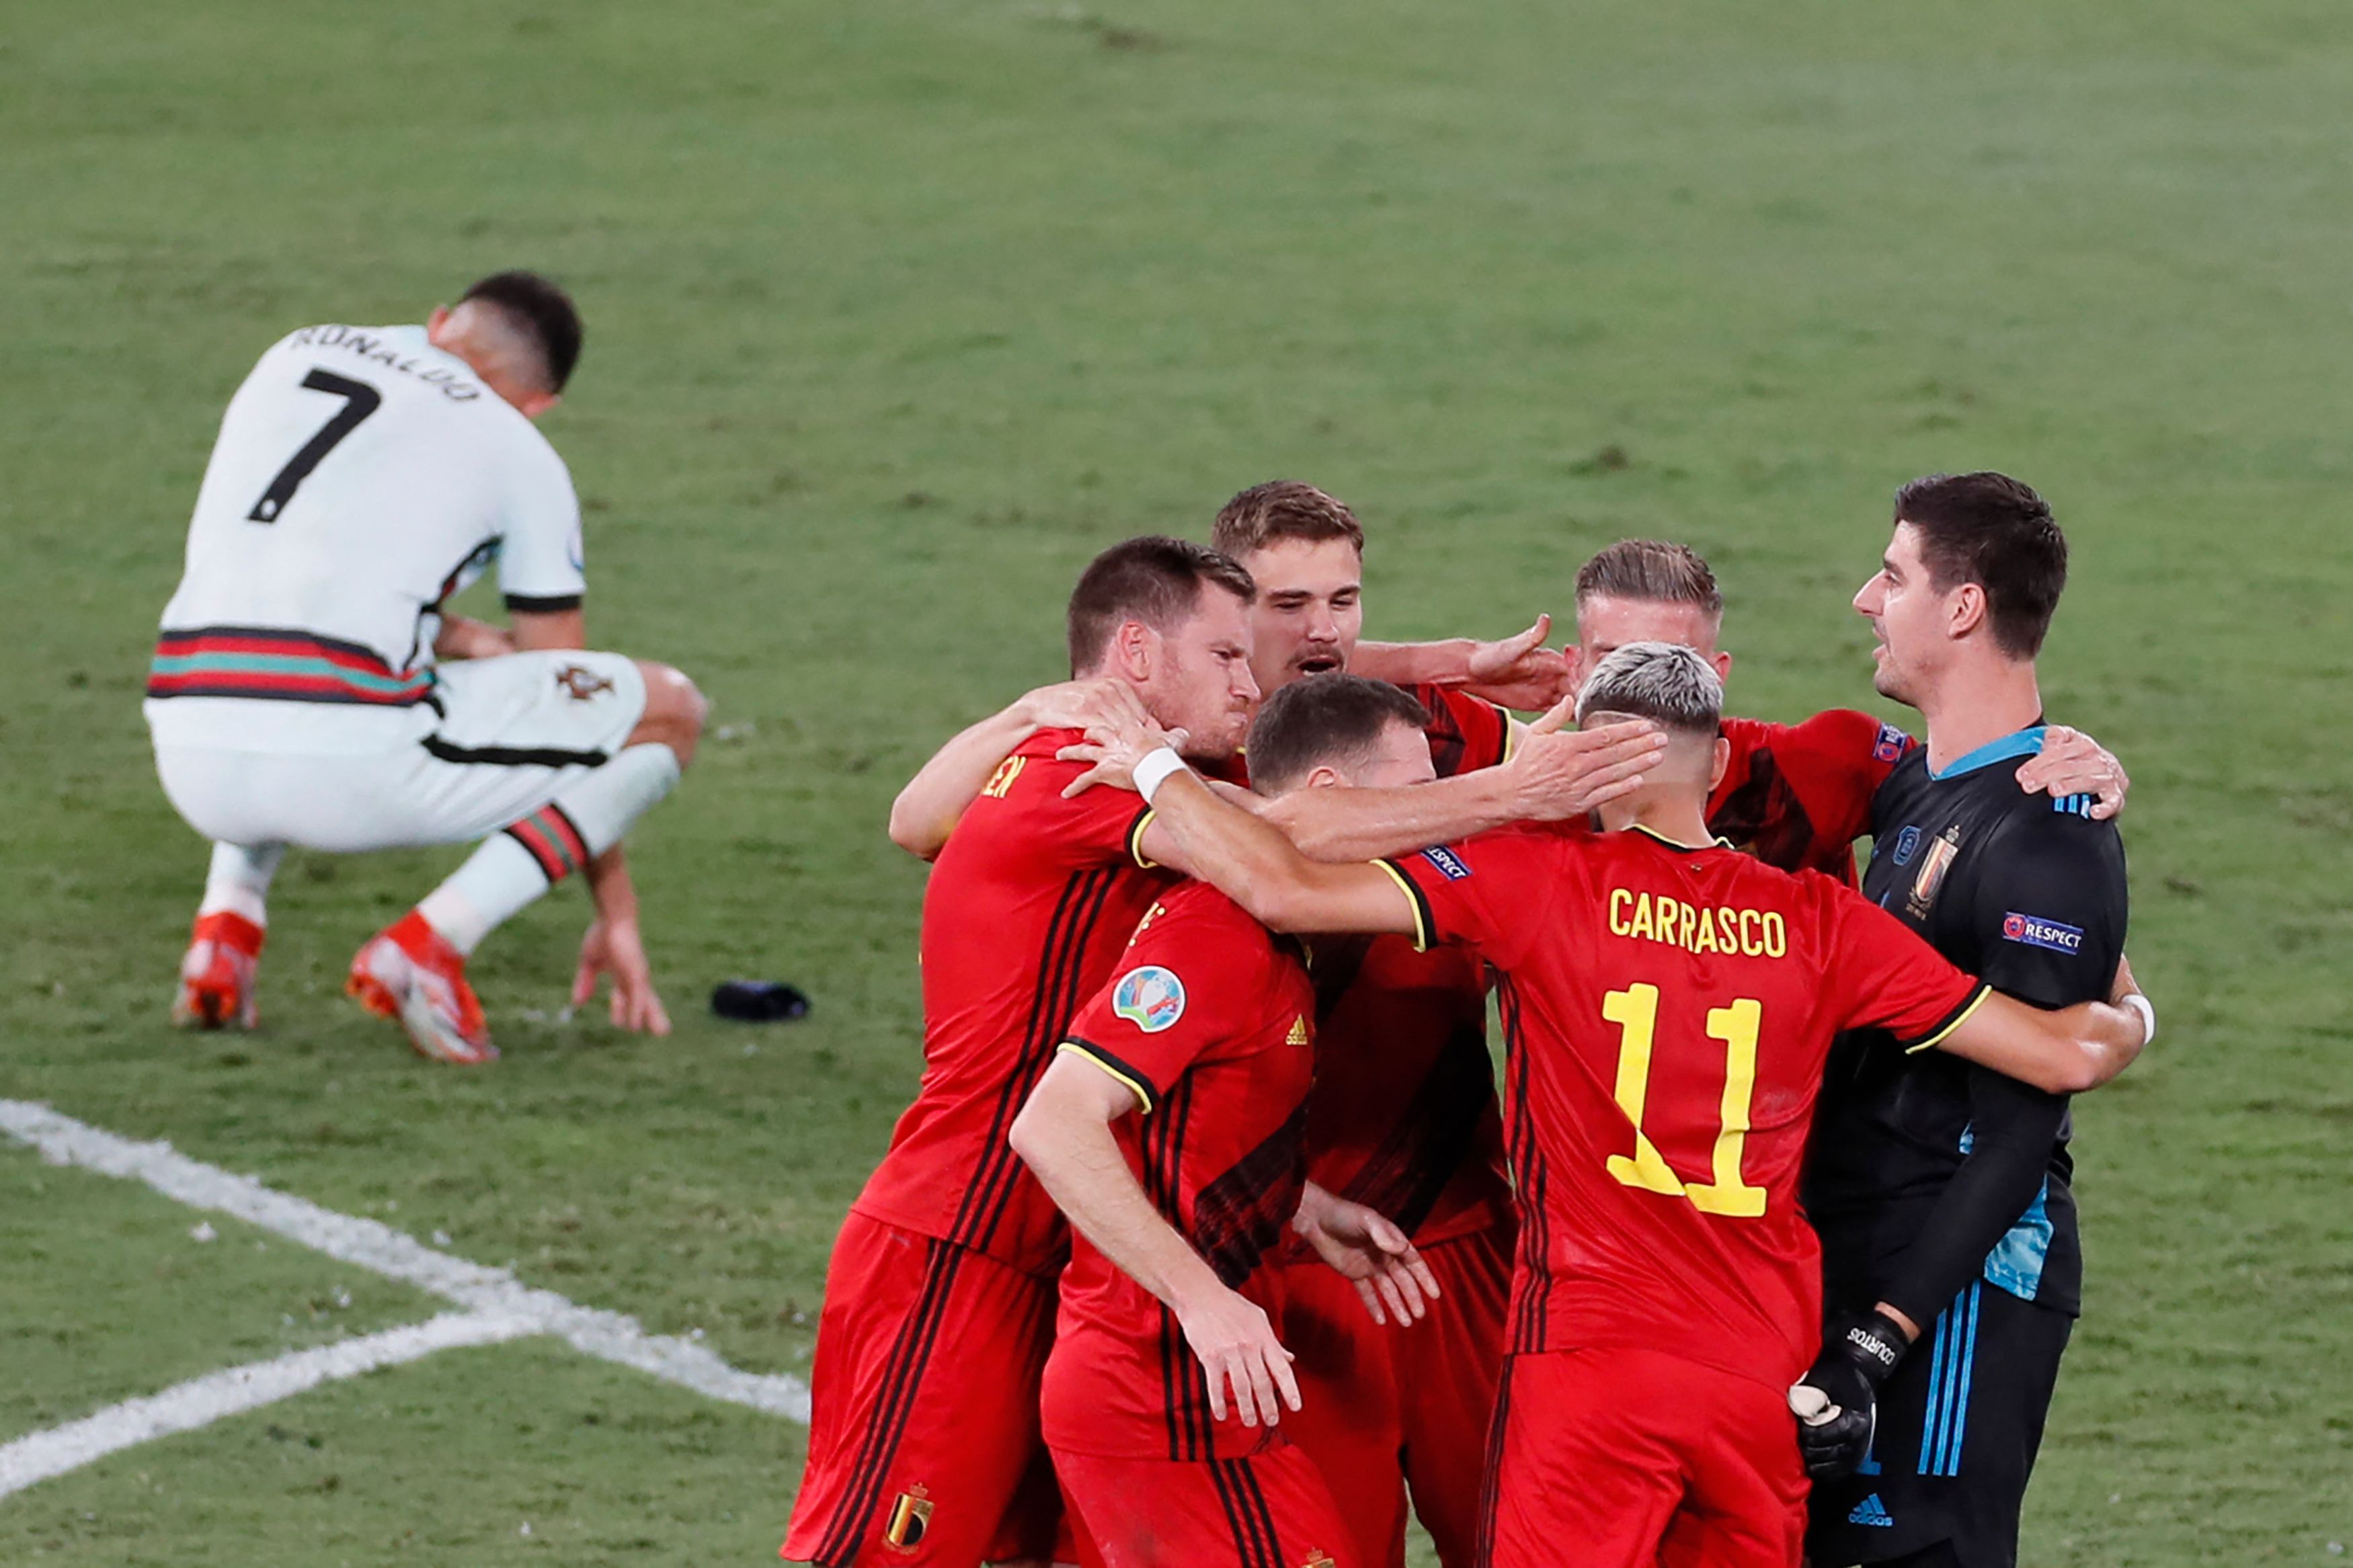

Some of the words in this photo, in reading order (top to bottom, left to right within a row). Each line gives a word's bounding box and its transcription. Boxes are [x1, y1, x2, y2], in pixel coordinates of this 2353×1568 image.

[290, 324, 480, 401] RONALDO
[247, 367, 382, 524] 7
[1609, 888, 1786, 958] CARRASCO
[2025, 923, 2082, 948] RESPECT
[1602, 982, 1767, 1218] 11
[1849, 1511, 1893, 1527] adidas
